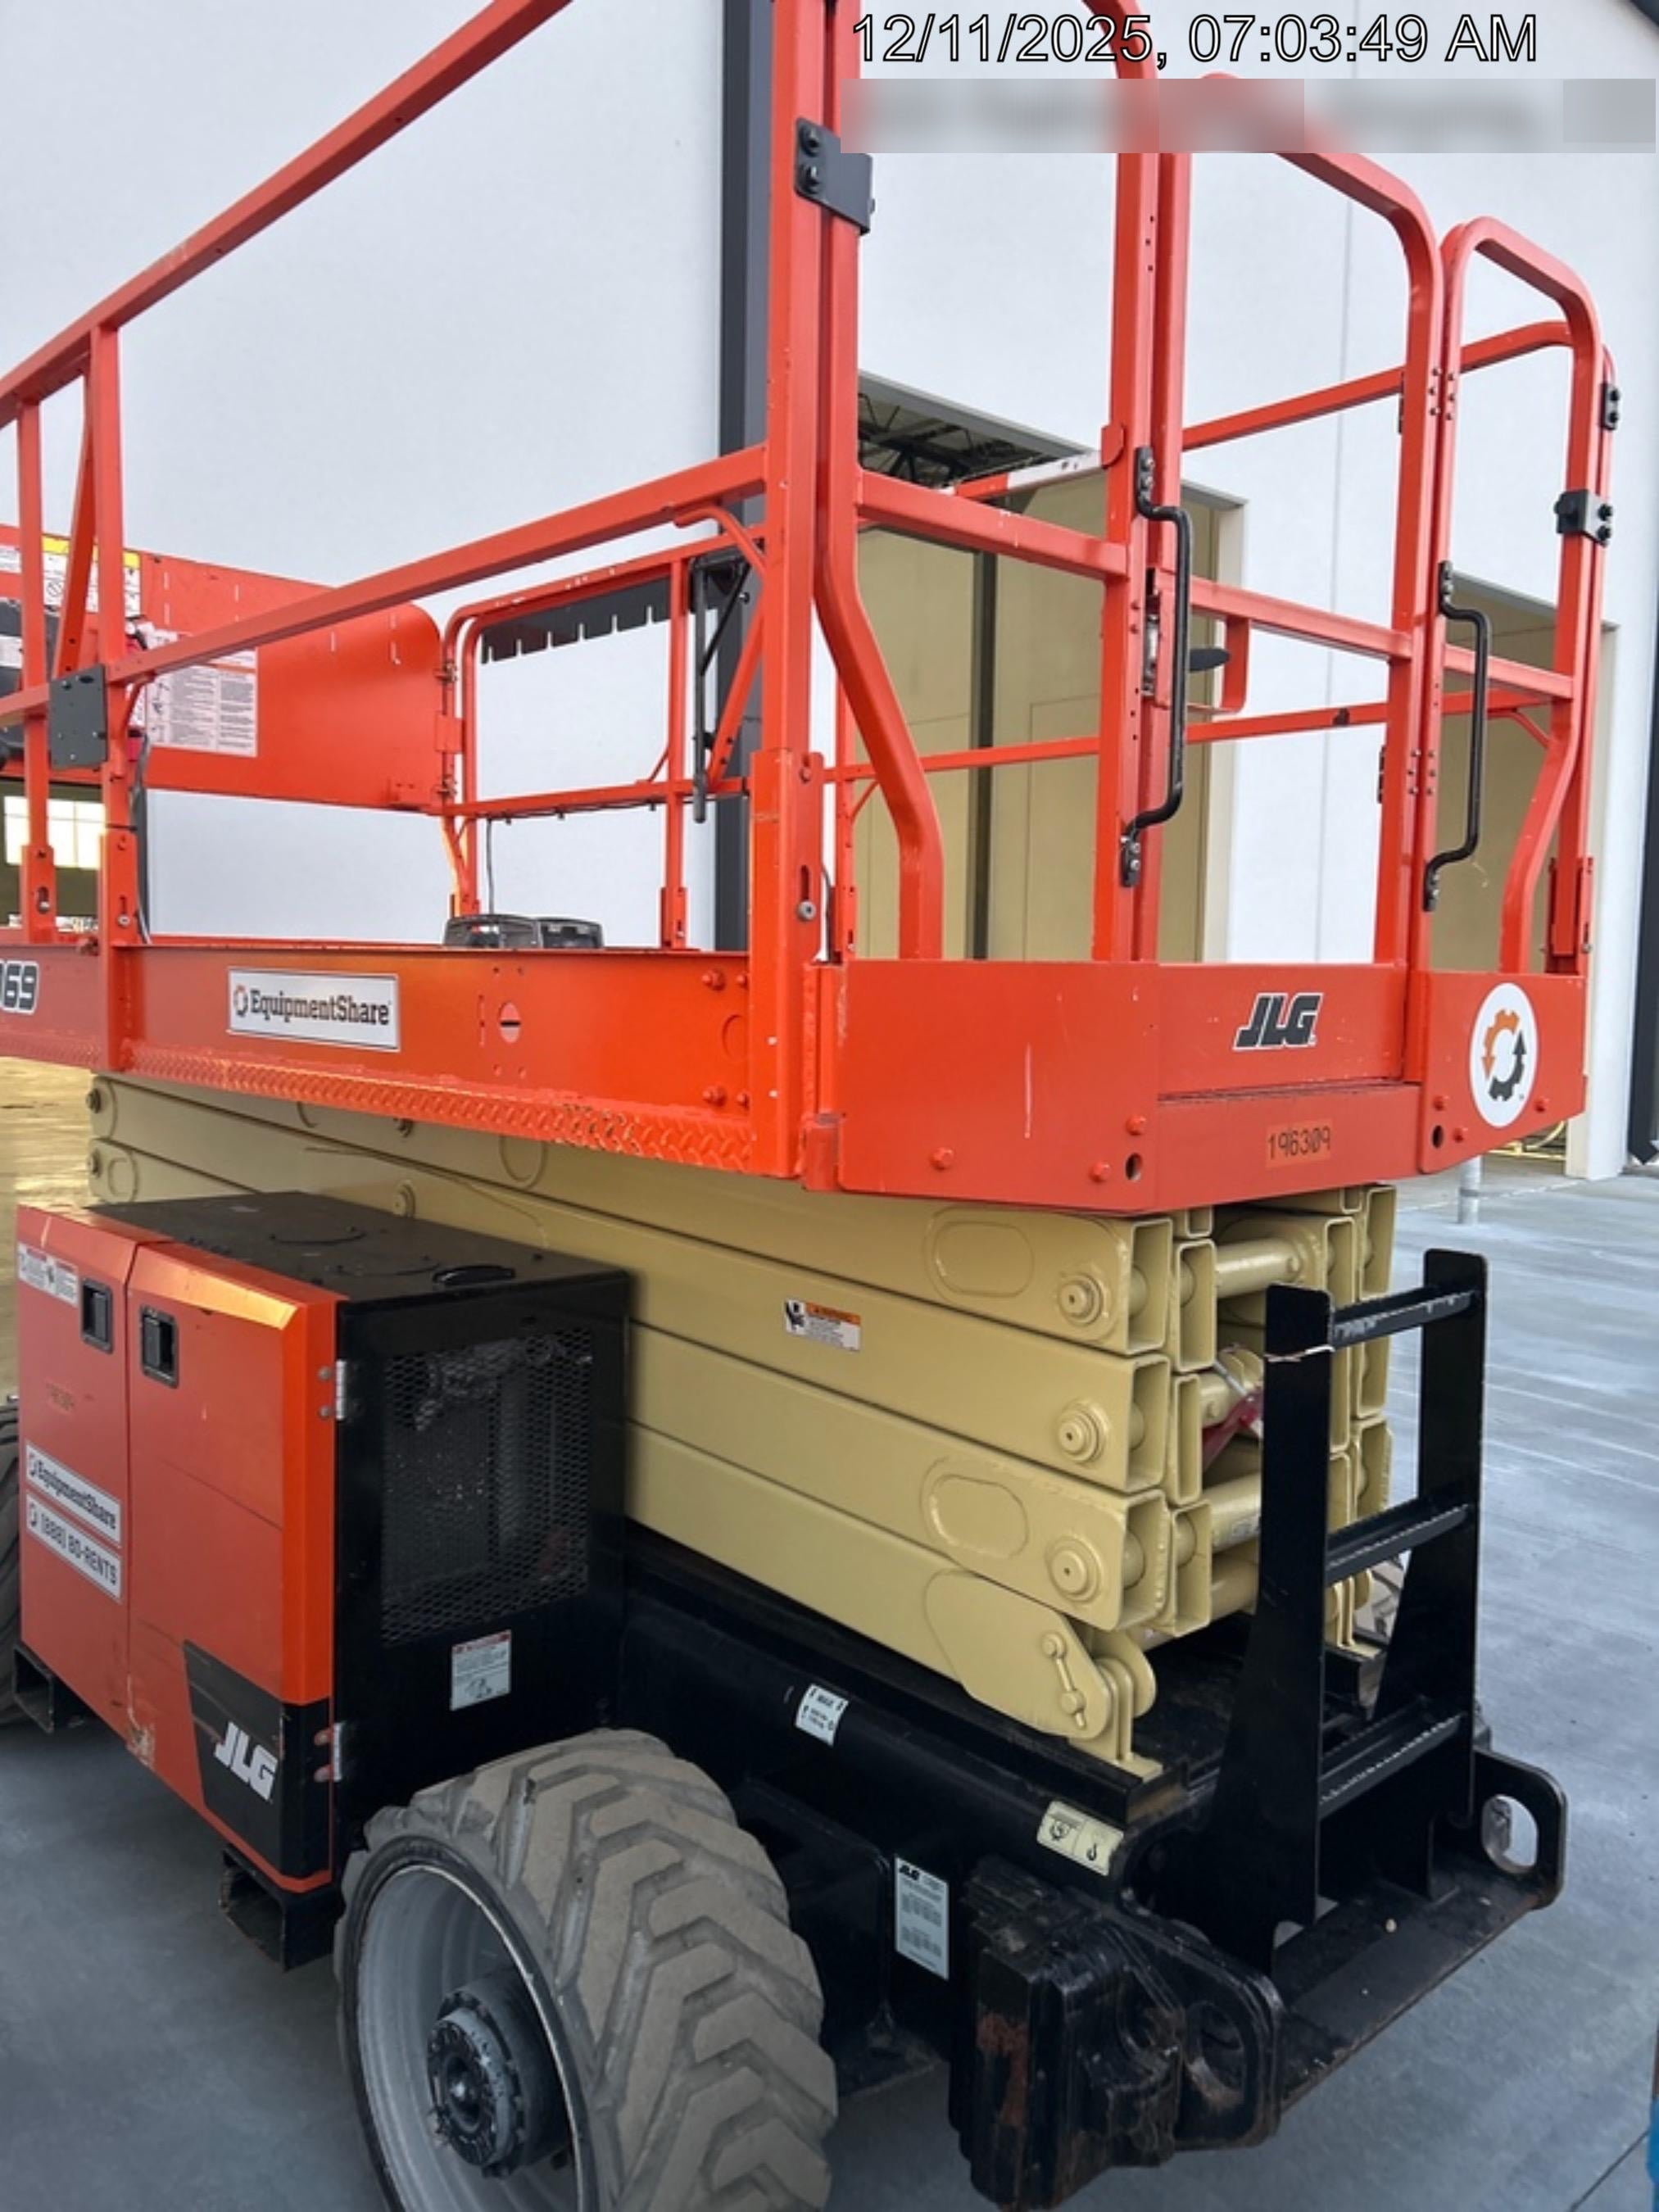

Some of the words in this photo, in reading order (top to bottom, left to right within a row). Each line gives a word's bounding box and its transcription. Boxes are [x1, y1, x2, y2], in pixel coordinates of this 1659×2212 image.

[0, 962, 39, 1012] 69
[250, 988, 390, 1026] EquipmentShare
[1234, 993, 1323, 1050] JLG
[1267, 1126, 1330, 1158] 196309
[214, 1721, 279, 1802] JLG
